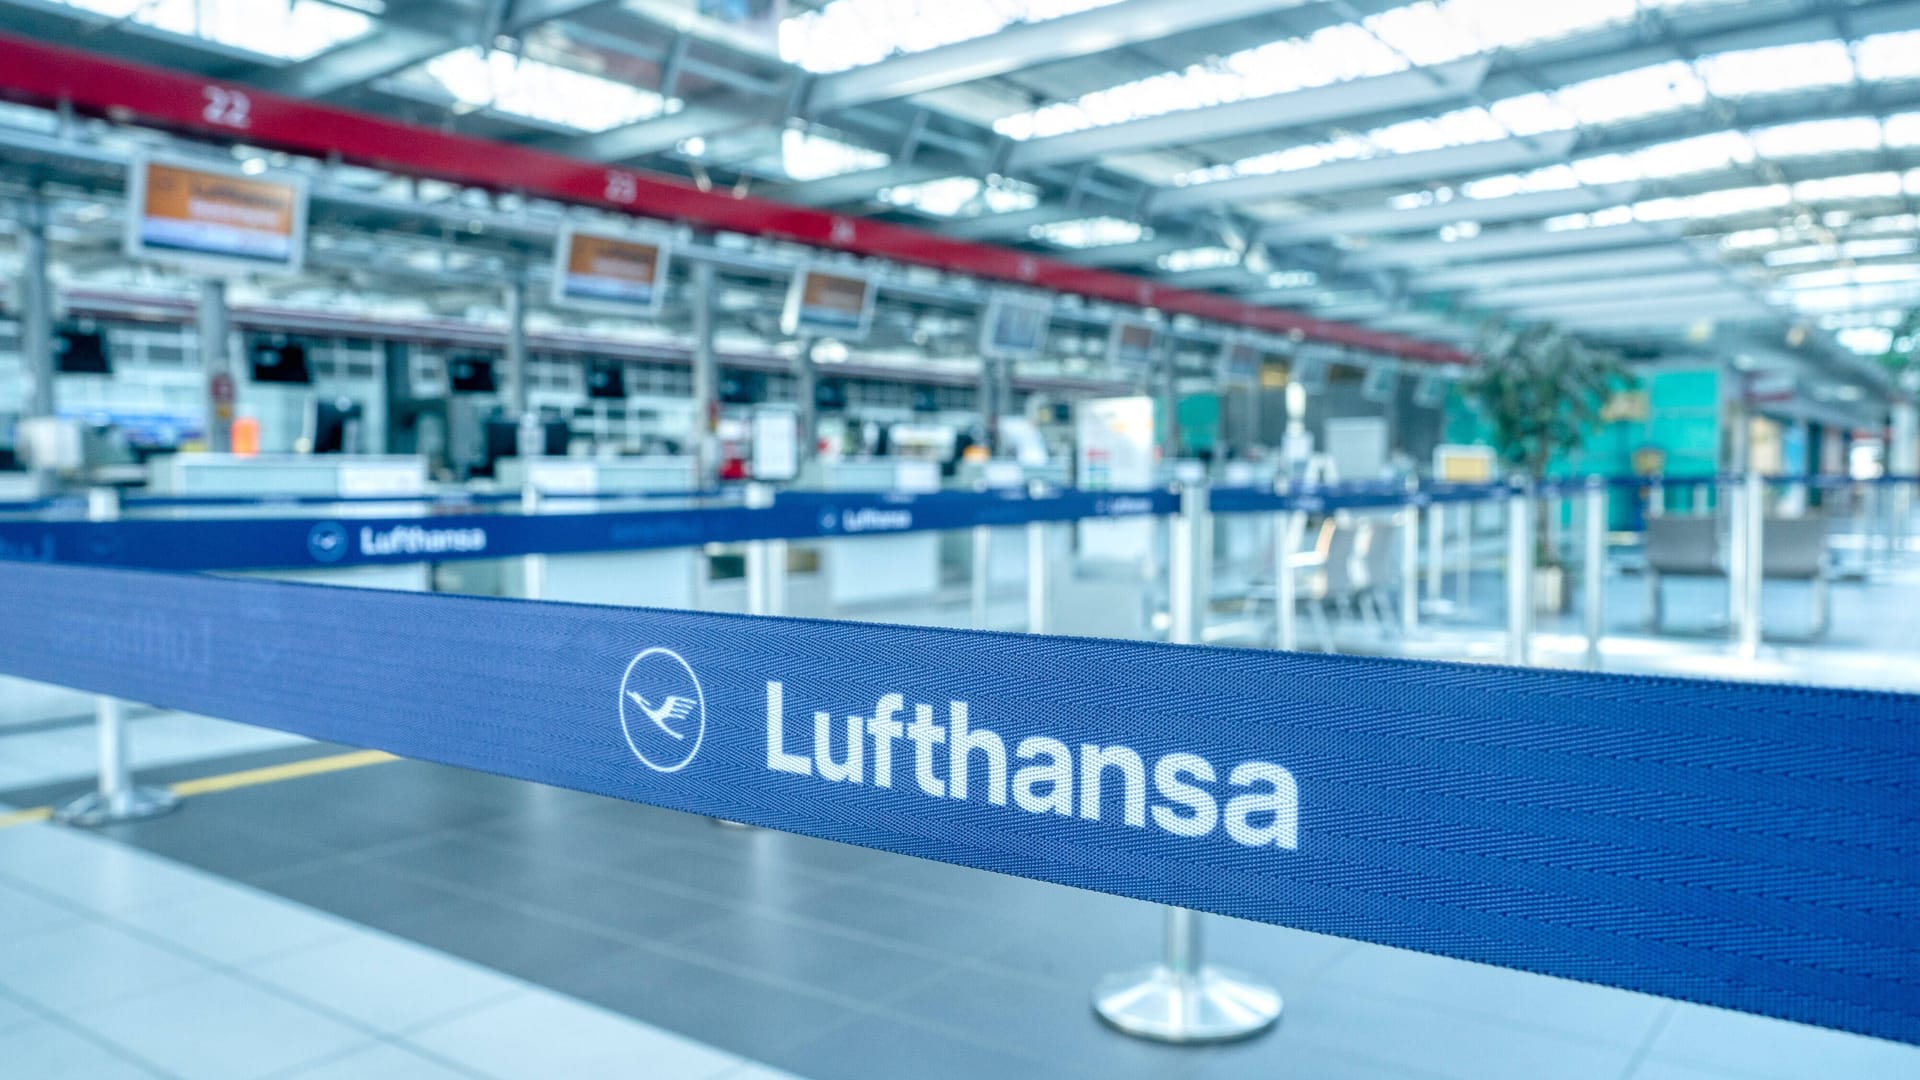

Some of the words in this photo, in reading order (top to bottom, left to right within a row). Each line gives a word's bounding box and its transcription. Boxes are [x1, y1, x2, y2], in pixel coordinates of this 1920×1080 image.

[203, 86, 251, 129] 22
[605, 169, 637, 204] 23
[360, 525, 487, 555] Lufthansa
[766, 681, 1299, 850] Lufthansa
